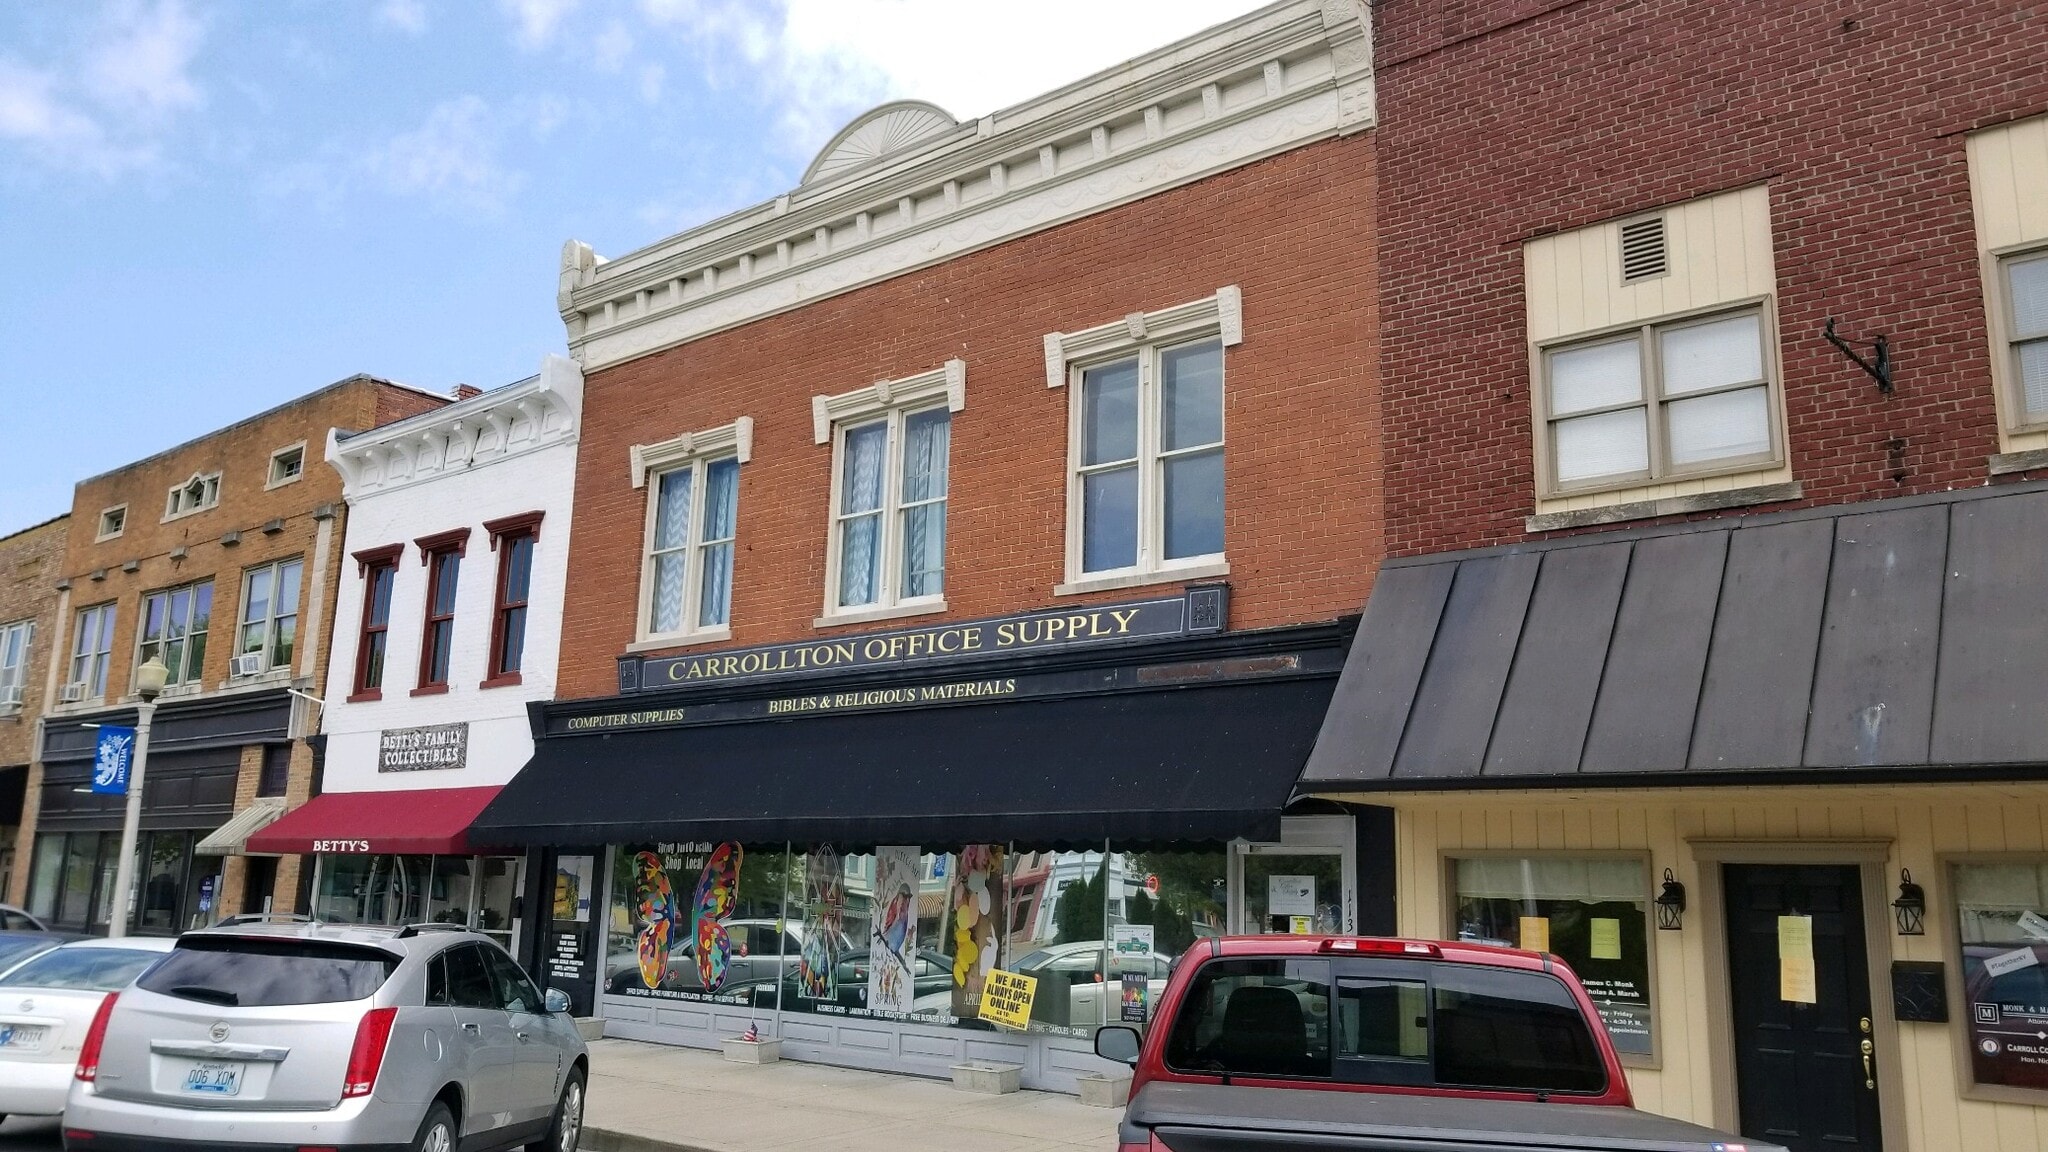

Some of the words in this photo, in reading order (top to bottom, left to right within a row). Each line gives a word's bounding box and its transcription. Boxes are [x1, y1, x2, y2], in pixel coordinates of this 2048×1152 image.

[669, 642, 857, 681] CARROLLTON
[864, 626, 982, 661] OFFICE
[997, 608, 1140, 647] SUPPLY
[768, 697, 816, 714] BIBLES
[819, 695, 831, 709] &
[834, 688, 916, 708] RELIGIOUS
[920, 678, 1016, 701] MATERIALS
[568, 714, 628, 730] COMPUTER
[630, 708, 684, 725] SUPPLIES
[383, 734, 420, 749] BETTY'S
[424, 730, 462, 746] FAMILY
[384, 747, 459, 766] COLLECTIBLES
[116, 748, 129, 784] WELCOME
[312, 840, 370, 852] BETTY'S
[665, 855, 682, 871] Shop
[685, 856, 704, 870] Local
[1990, 954, 2027, 970] #TogetherKY
[995, 973, 1009, 986] WE
[1010, 977, 1028, 991] ARE
[1614, 980, 1634, 988] Monk
[875, 992, 902, 1006] SPRING
[986, 983, 1013, 1000] ALWAYS
[1013, 990, 1032, 1005] OPEN
[1617, 989, 1640, 998] Marsh
[990, 996, 1021, 1014] ONLINE
[2002, 1004, 2025, 1012] MONK
[1613, 1010, 1633, 1018] Friday
[1048, 1025, 1069, 1035] CANDLES
[1072, 1027, 1089, 1037] CARDS
[1609, 1026, 1649, 1035] Appointment
[2007, 1043, 2038, 1054] CARROLL
[188, 1069, 209, 1084] 006
